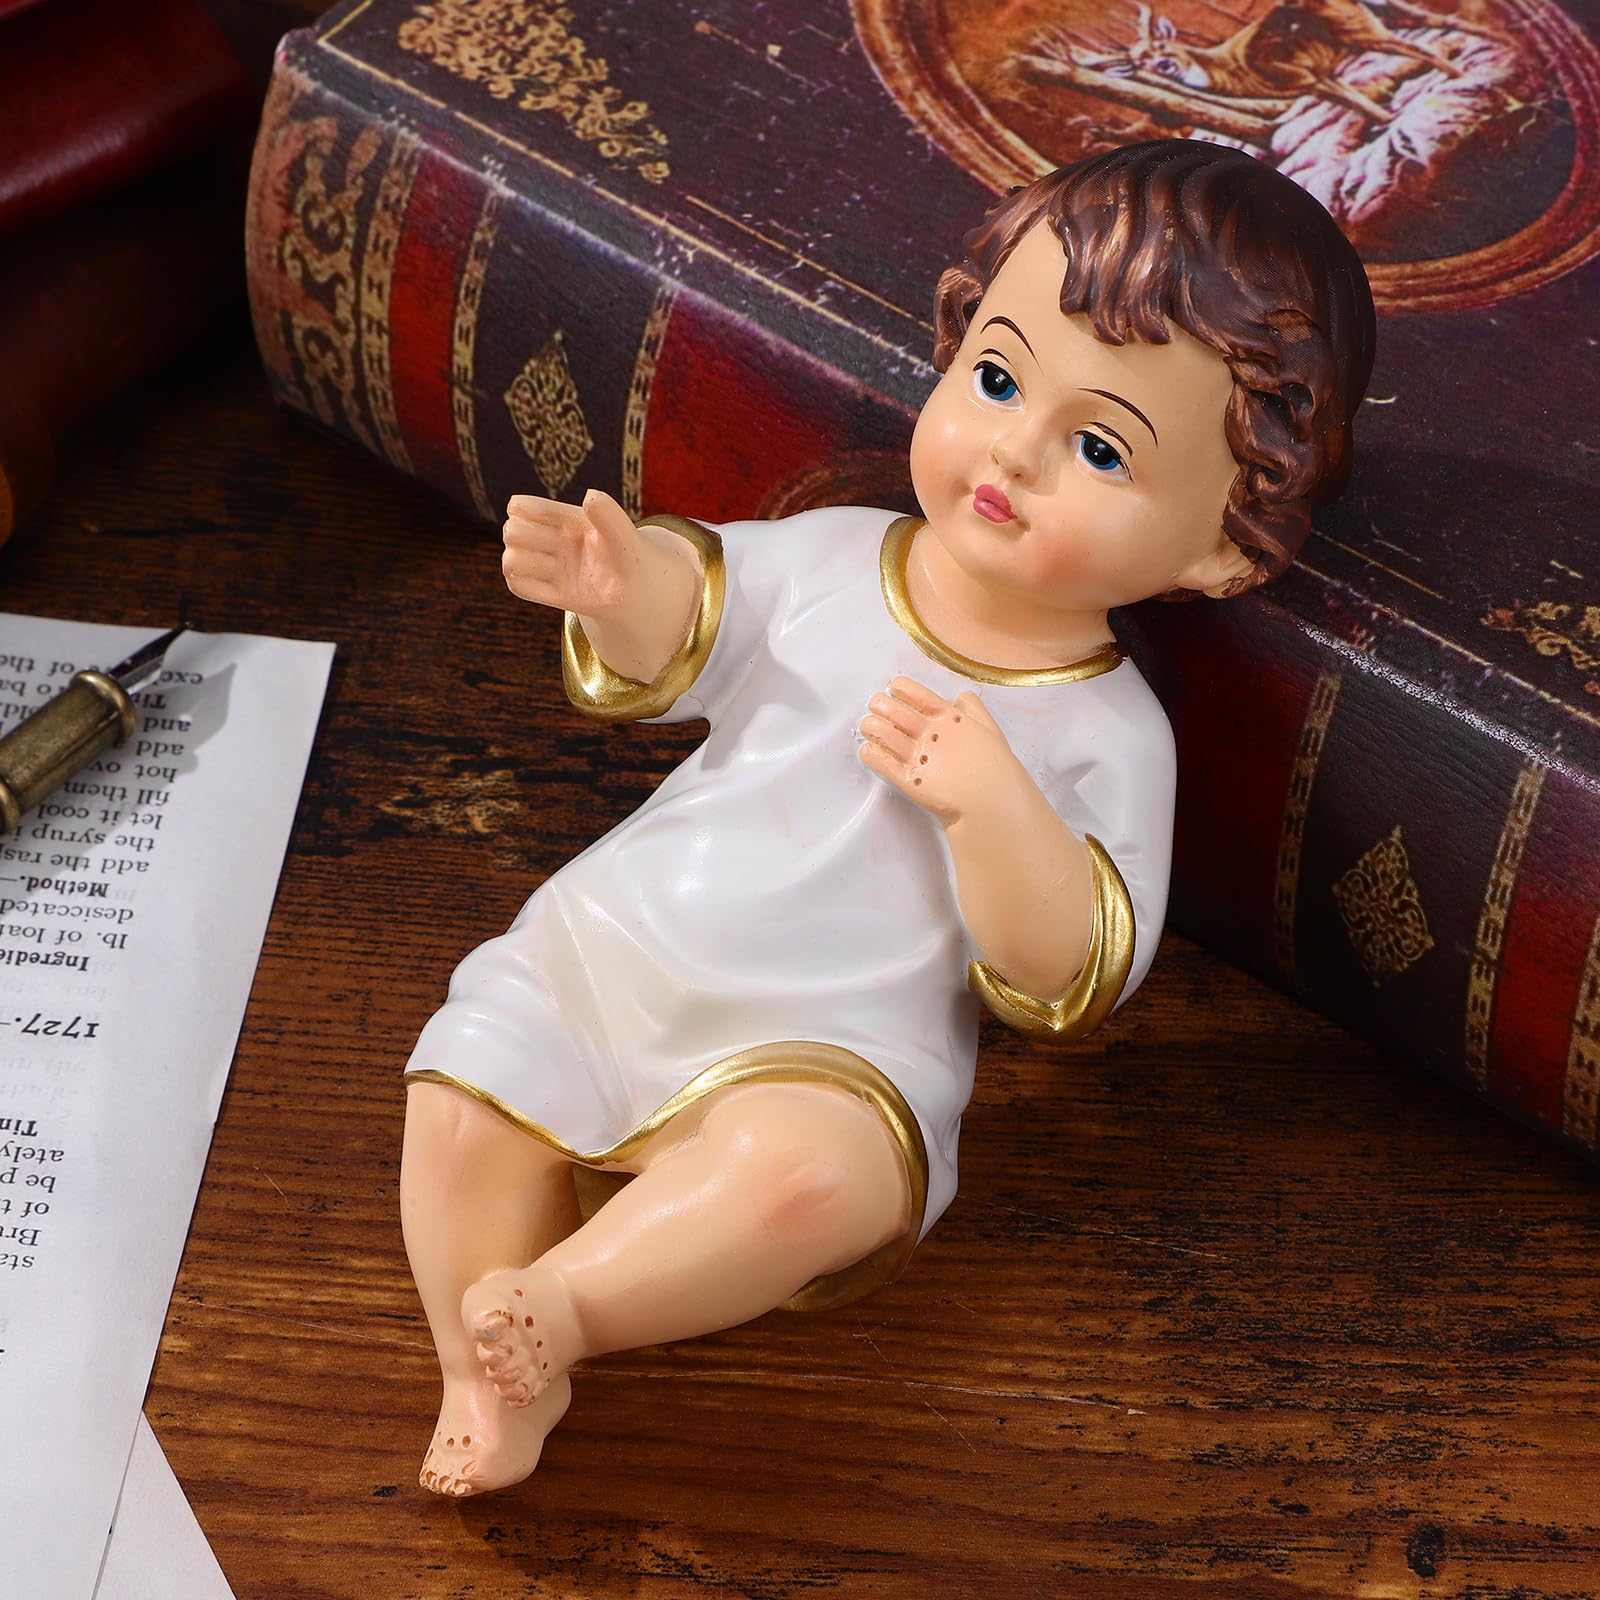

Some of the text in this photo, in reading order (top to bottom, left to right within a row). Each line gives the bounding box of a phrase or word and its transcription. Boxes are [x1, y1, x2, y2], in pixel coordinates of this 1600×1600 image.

[47, 661, 75, 677] of
[142, 717, 192, 733] and
[135, 741, 185, 757] add
[134, 764, 179, 783] hot
[63, 781, 171, 806] fill them
[37, 804, 164, 830] let it cool
[31, 823, 107, 844] syrup
[114, 835, 155, 852] the
[50, 854, 90, 872] the
[100, 858, 150, 874] add
[0, 898, 134, 924] desiccated
[54, 929, 83, 945] of
[96, 932, 129, 949] lb.
[0, 1140, 64, 1165] ately
[25, 1174, 56, 1193] be
[20, 1201, 50, 1218] of
